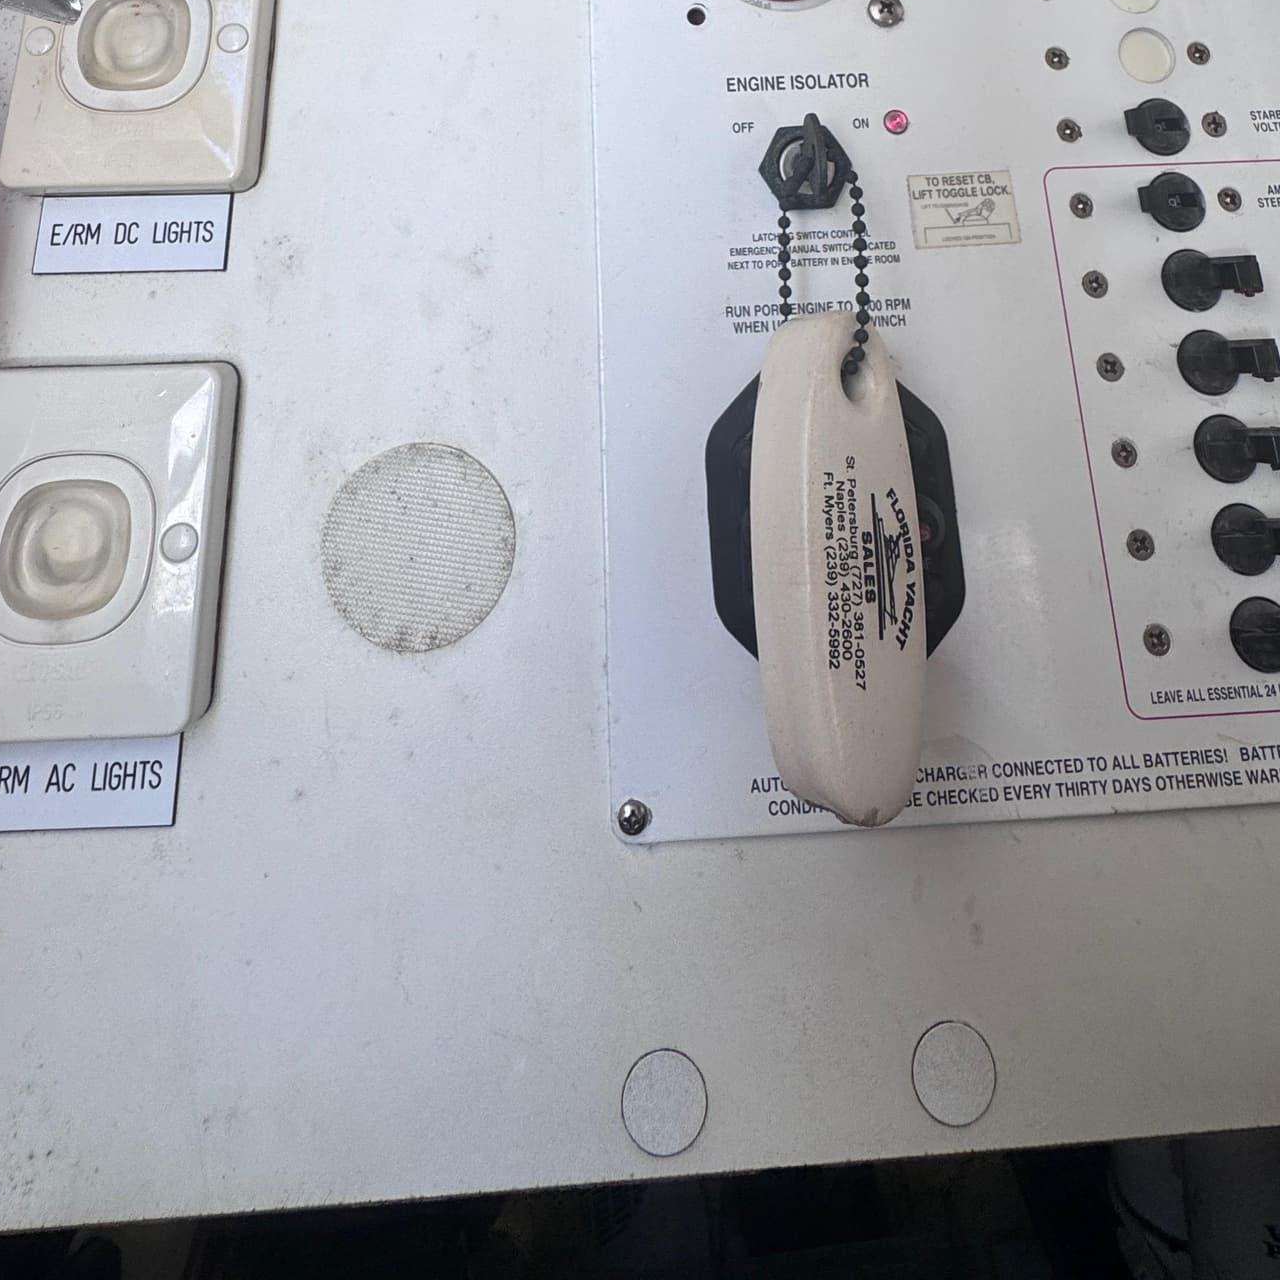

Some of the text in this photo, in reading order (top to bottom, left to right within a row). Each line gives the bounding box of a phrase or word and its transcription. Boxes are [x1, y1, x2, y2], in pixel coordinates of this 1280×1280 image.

[726, 72, 869, 92] ENGINE ISOLATOR
[732, 118, 870, 133] OFF ON
[925, 177, 939, 187] TO
[941, 175, 975, 186] RESET
[912, 189, 934, 200] LIFT
[936, 186, 978, 199] TOGGLE
[50, 220, 215, 246] E/RM DC LIGHTS
[752, 232, 795, 242] LATCHG
[796, 231, 829, 240] SWITCH
[862, 241, 896, 250] CATED
[728, 261, 750, 270] NEXT
[752, 261, 764, 269] TO
[765, 259, 784, 269] POR
[791, 257, 829, 268] BATTERY
[831, 257, 839, 266] IN
[875, 254, 901, 265] ROOM
[725, 306, 751, 318] RUN
[754, 304, 785, 316] POR
[791, 301, 833, 315] ENGINE
[837, 301, 853, 311] TO
[885, 298, 911, 311] RPM
[733, 321, 769, 334] WHEN
[822, 472, 840, 670] Ft. Myers (239) 332-5992
[834, 481, 846, 532] Naples
[840, 582, 853, 661] 430-2600
[845, 455, 866, 691] St. Petersburg (727) 381-0527
[862, 531, 876, 604] SALES
[886, 488, 916, 651] FLORIDA YACHT
[1150, 688, 1184, 705] LEAVE
[1186, 687, 1206, 702] ALL
[1208, 684, 1263, 701] ESSENTIAL
[1265, 684, 1277, 697] 24
[45, 763, 77, 793] AC
[91, 760, 163, 792] LIGHTS
[916, 764, 987, 783] CHARGER
[992, 757, 1084, 779] CONNECTED
[1087, 756, 1108, 771] TO
[1112, 753, 1140, 770] ALL
[1143, 749, 1229, 769] BATTERIES!
[927, 787, 999, 806] CHECKED
[1003, 783, 1052, 802] EVERY
[1055, 779, 1109, 799] THIRTY
[1112, 777, 1152, 795] DAYS
[1155, 771, 1243, 792] OTHERWISE
